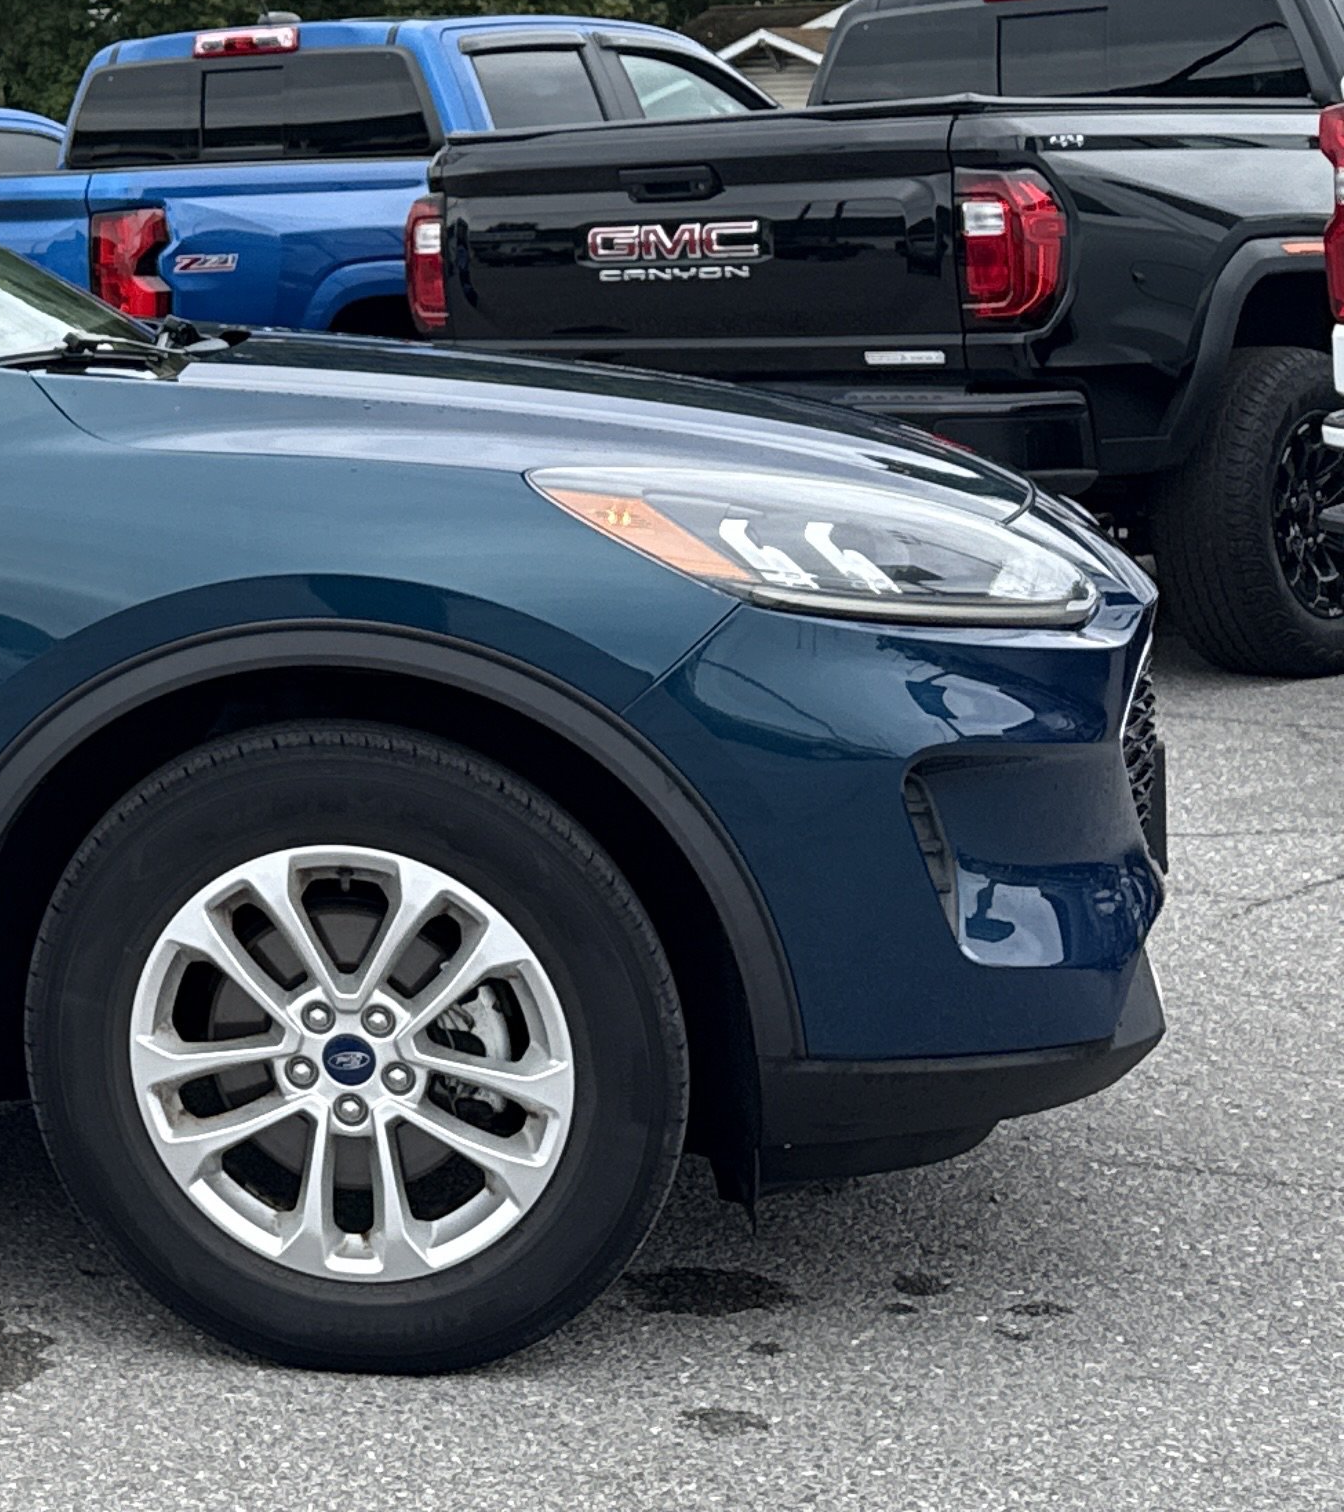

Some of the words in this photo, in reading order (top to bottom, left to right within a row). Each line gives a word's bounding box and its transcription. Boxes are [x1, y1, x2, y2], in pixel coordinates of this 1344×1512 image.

[588, 220, 759, 261] GMC
[173, 253, 239, 273] Z71
[599, 265, 750, 281] CANYON
